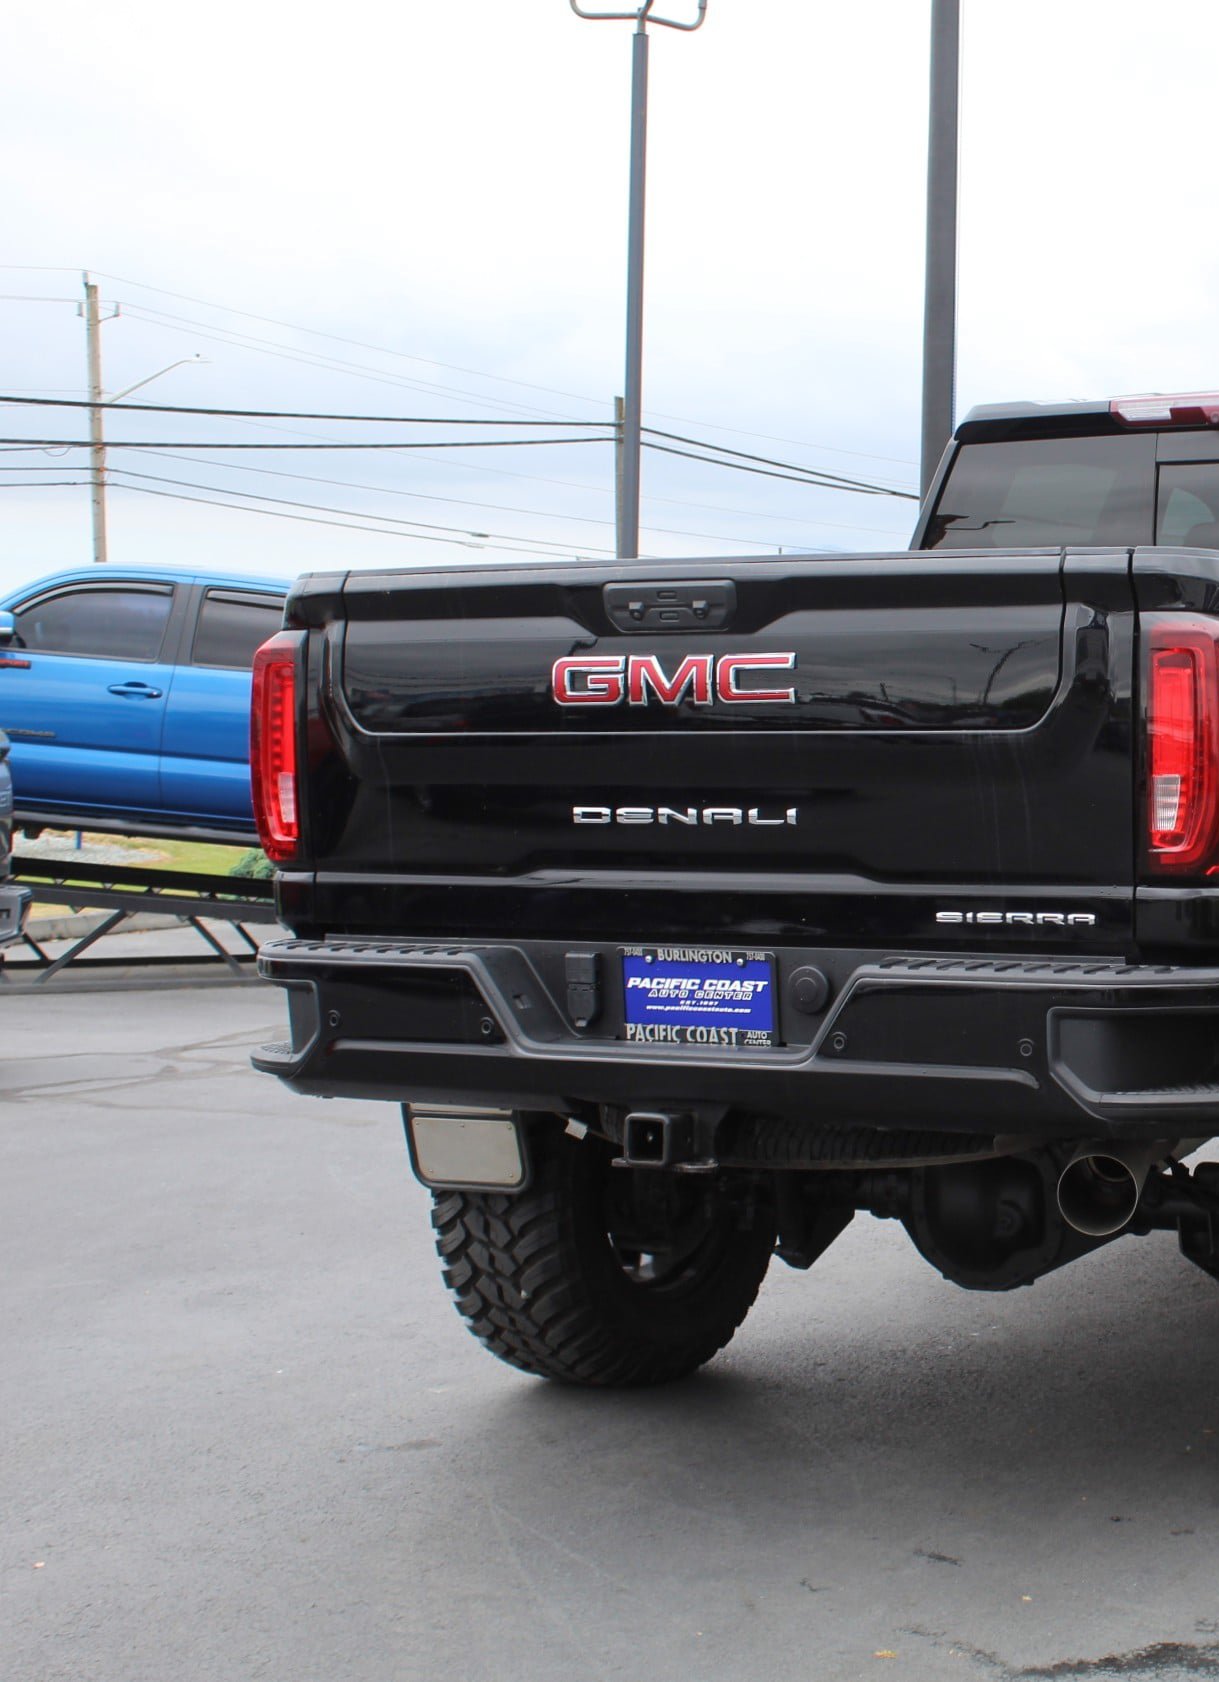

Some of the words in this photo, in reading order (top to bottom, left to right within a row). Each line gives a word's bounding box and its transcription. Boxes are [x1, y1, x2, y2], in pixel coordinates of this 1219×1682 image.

[552, 652, 796, 706] GMC
[573, 806, 797, 825] DENALI
[935, 911, 1096, 925] SIERRA
[658, 948, 732, 963] BURLINGTON
[627, 977, 700, 989] PACIFIC
[704, 979, 768, 992] COAST
[648, 990, 688, 998] AUTO
[694, 991, 752, 1000] CENTER
[625, 1022, 681, 1044] PACIFIC
[686, 1025, 739, 1047] COAST
[746, 1030, 768, 1039] AUTO
